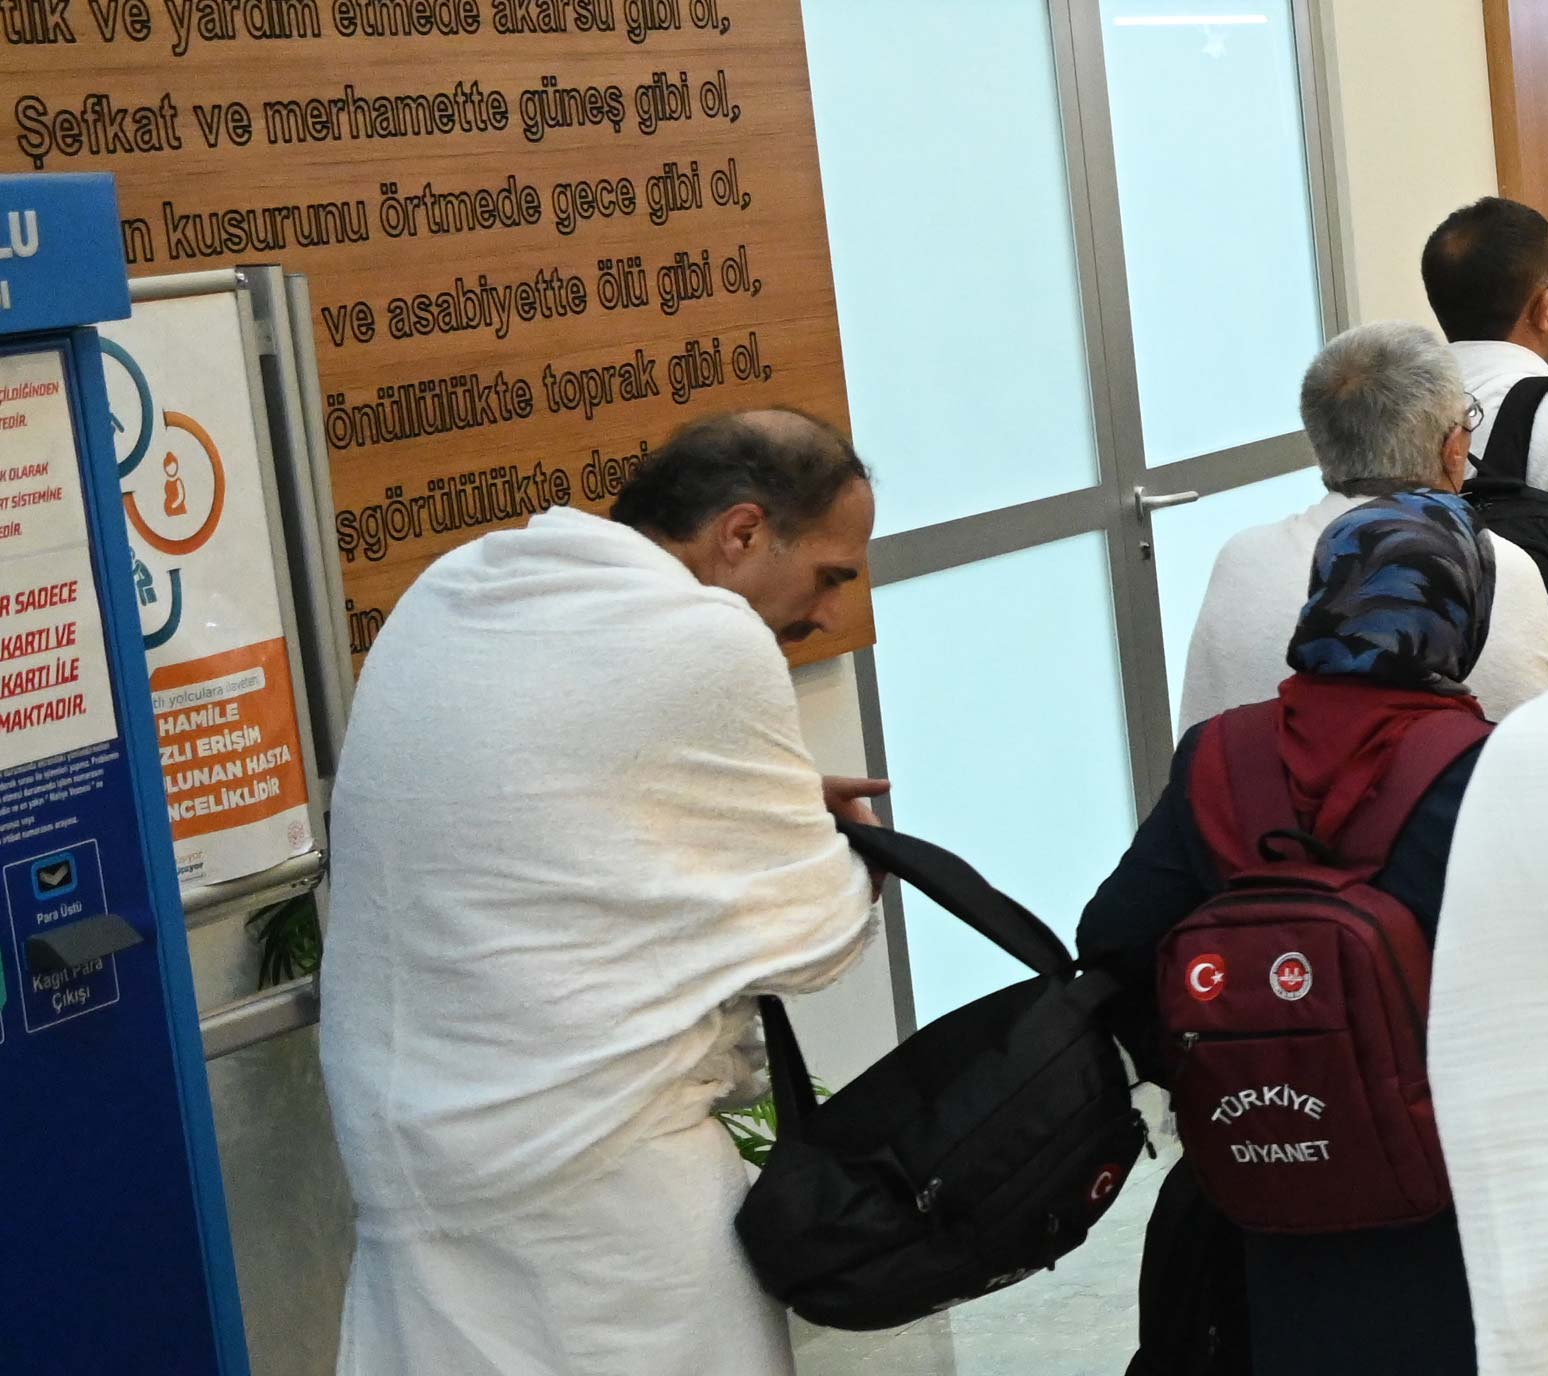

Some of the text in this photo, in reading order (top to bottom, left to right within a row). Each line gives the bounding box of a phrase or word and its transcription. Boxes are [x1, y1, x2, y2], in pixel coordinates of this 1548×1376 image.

[15, 70, 741, 169] Şefkat ve merhamette güneş gibi ol,
[163, 200, 369, 260] kusurunu
[380, 175, 541, 238] örtmede
[552, 177, 636, 236] gece
[645, 161, 702, 226] gibi
[710, 158, 752, 210] ol,
[321, 245, 762, 346] ve asabiyette ölü gibi ol,
[326, 332, 772, 450] önüllülükte toprak gibi ol,
[9, 462, 49, 481] OLARAK
[12, 488, 62, 508] SİSTEMİNE
[336, 461, 571, 561] şgörülülükte
[15, 581, 78, 613] SADECE
[1, 622, 76, 661] KARTI VE
[1, 657, 79, 698] KARTI İLE
[169, 684, 223, 708] yolculara
[159, 702, 239, 737] HAMİLE
[197, 725, 261, 757] ERİŞİM
[246, 744, 291, 775] HASTA
[37, 902, 82, 924] Para Üstü
[52, 987, 90, 1014] Çıkışı
[1211, 1084, 1325, 1125] TÜRKİYE
[1231, 1141, 1330, 1162] DİYANET
